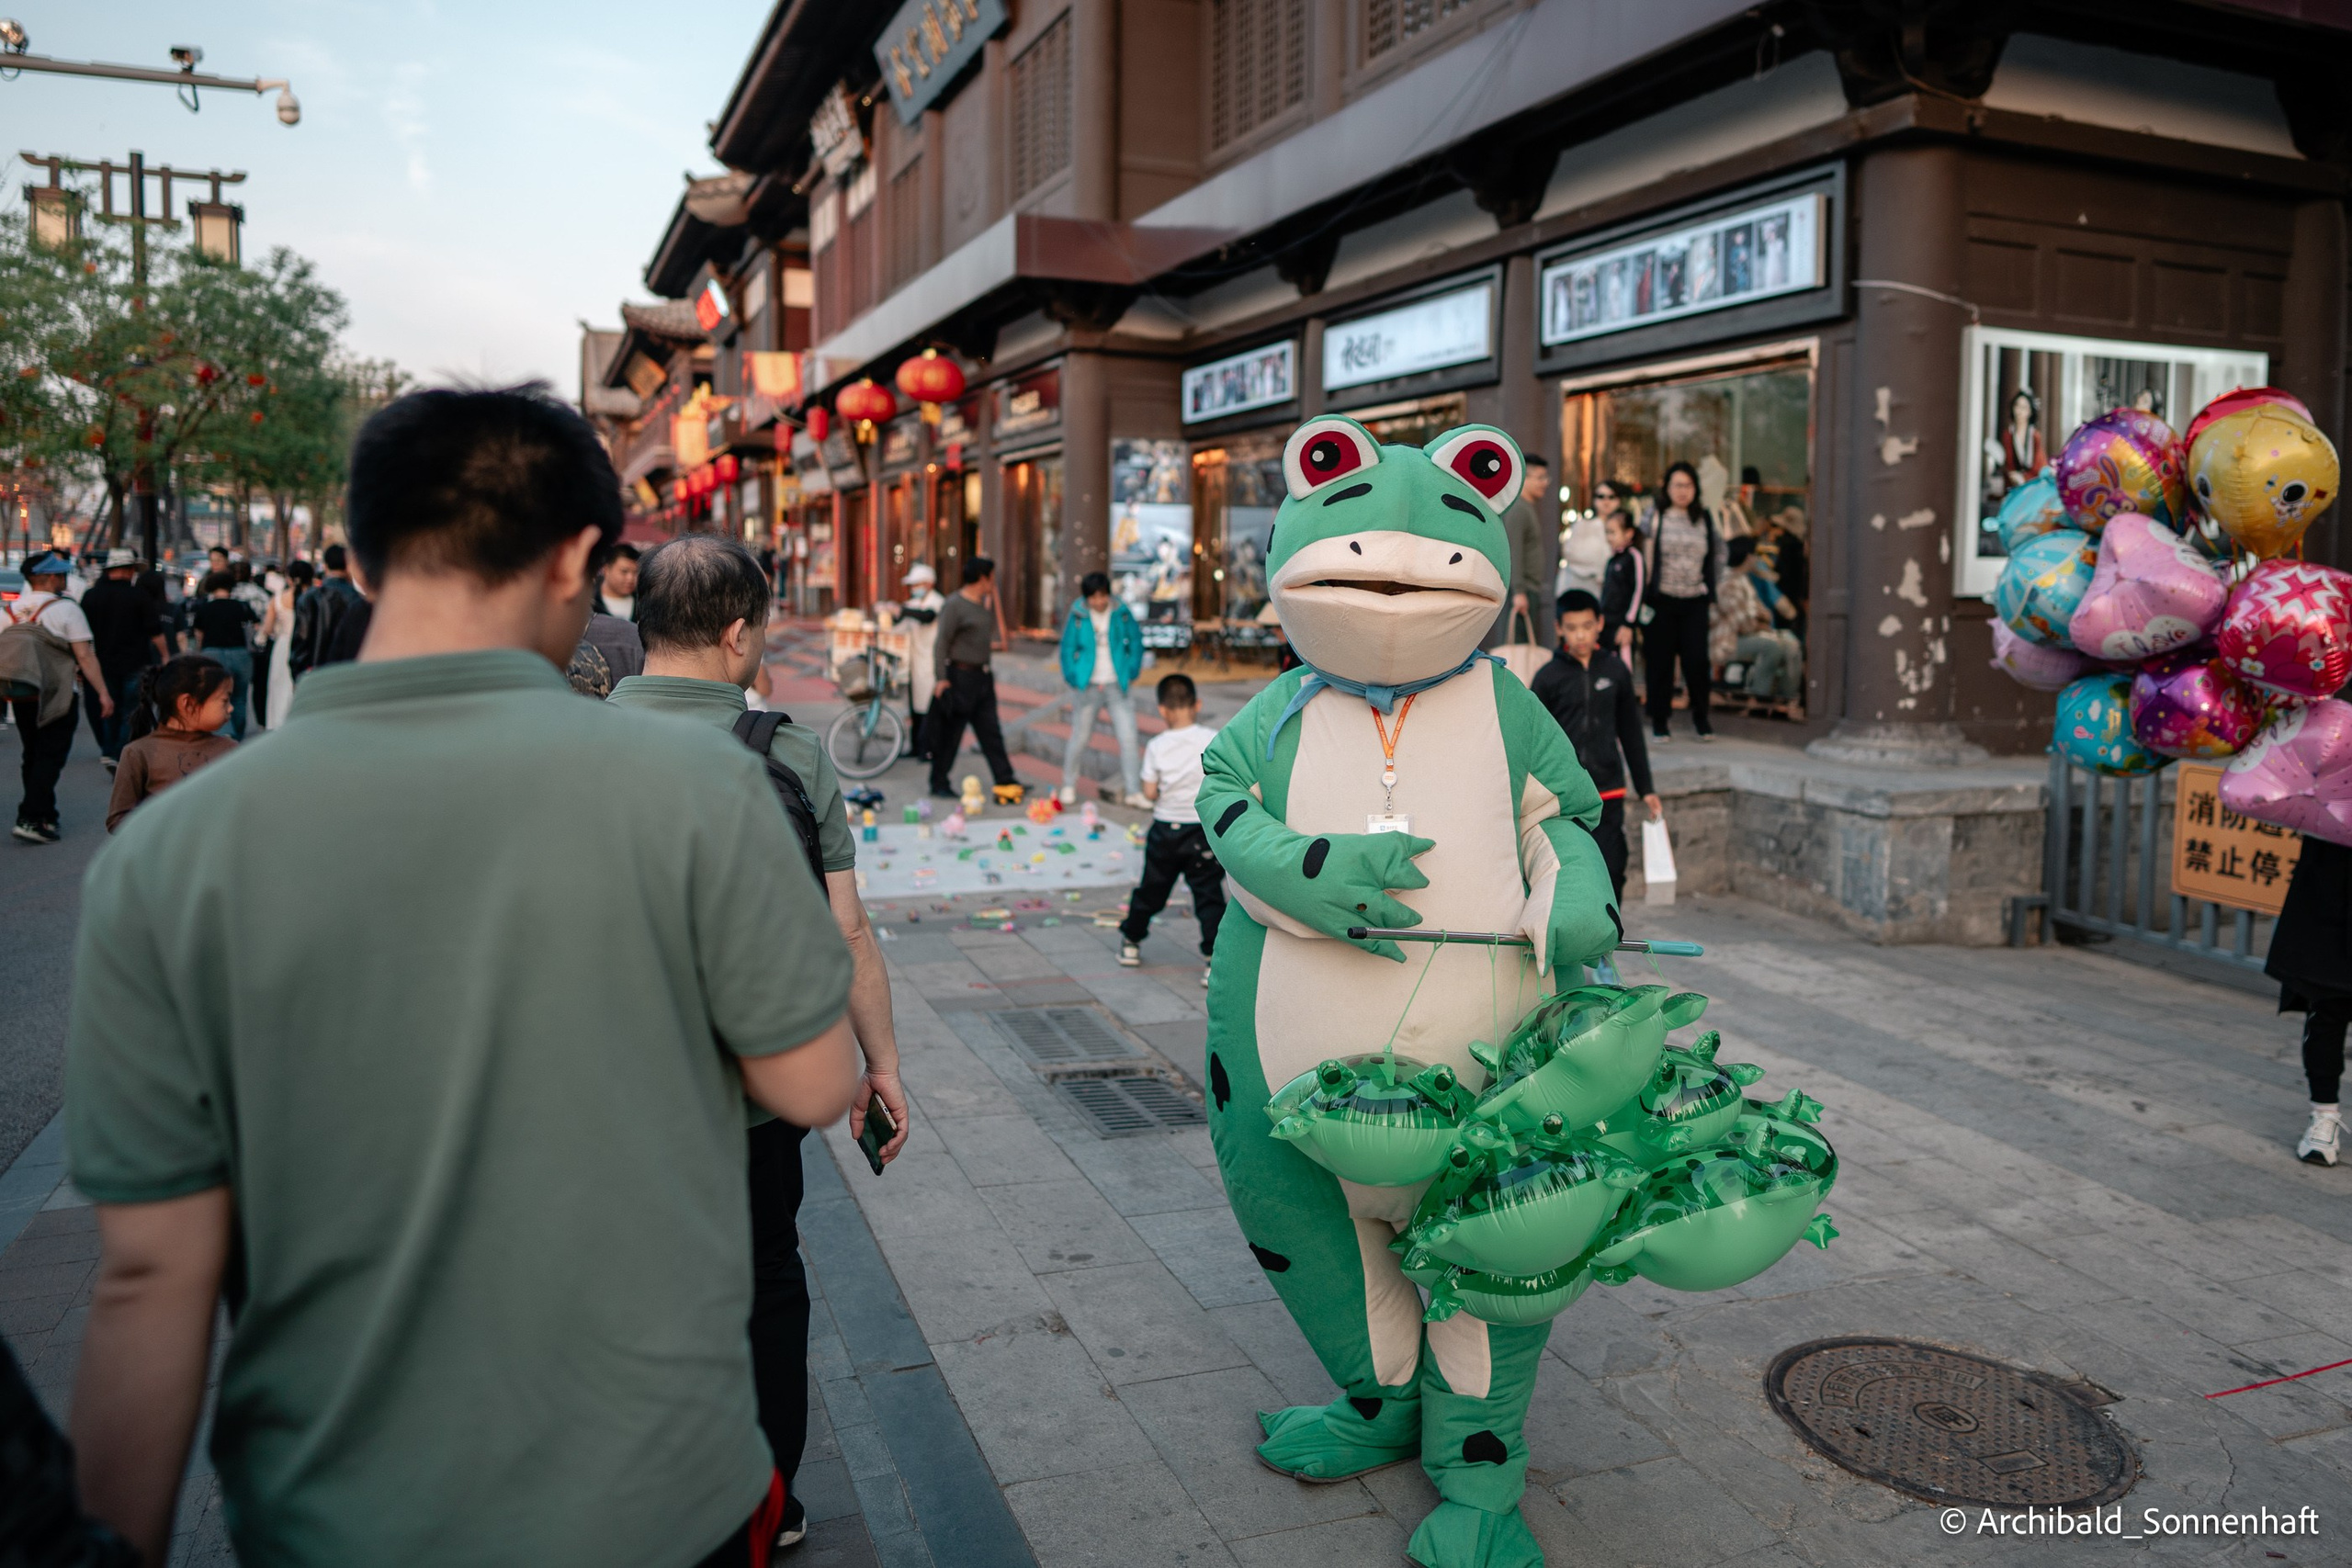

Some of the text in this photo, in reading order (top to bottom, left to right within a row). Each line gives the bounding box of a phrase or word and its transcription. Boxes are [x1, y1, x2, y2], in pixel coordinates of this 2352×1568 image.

[2188, 789, 2303, 840] 消防
[2185, 837, 2299, 886] 禁止停
